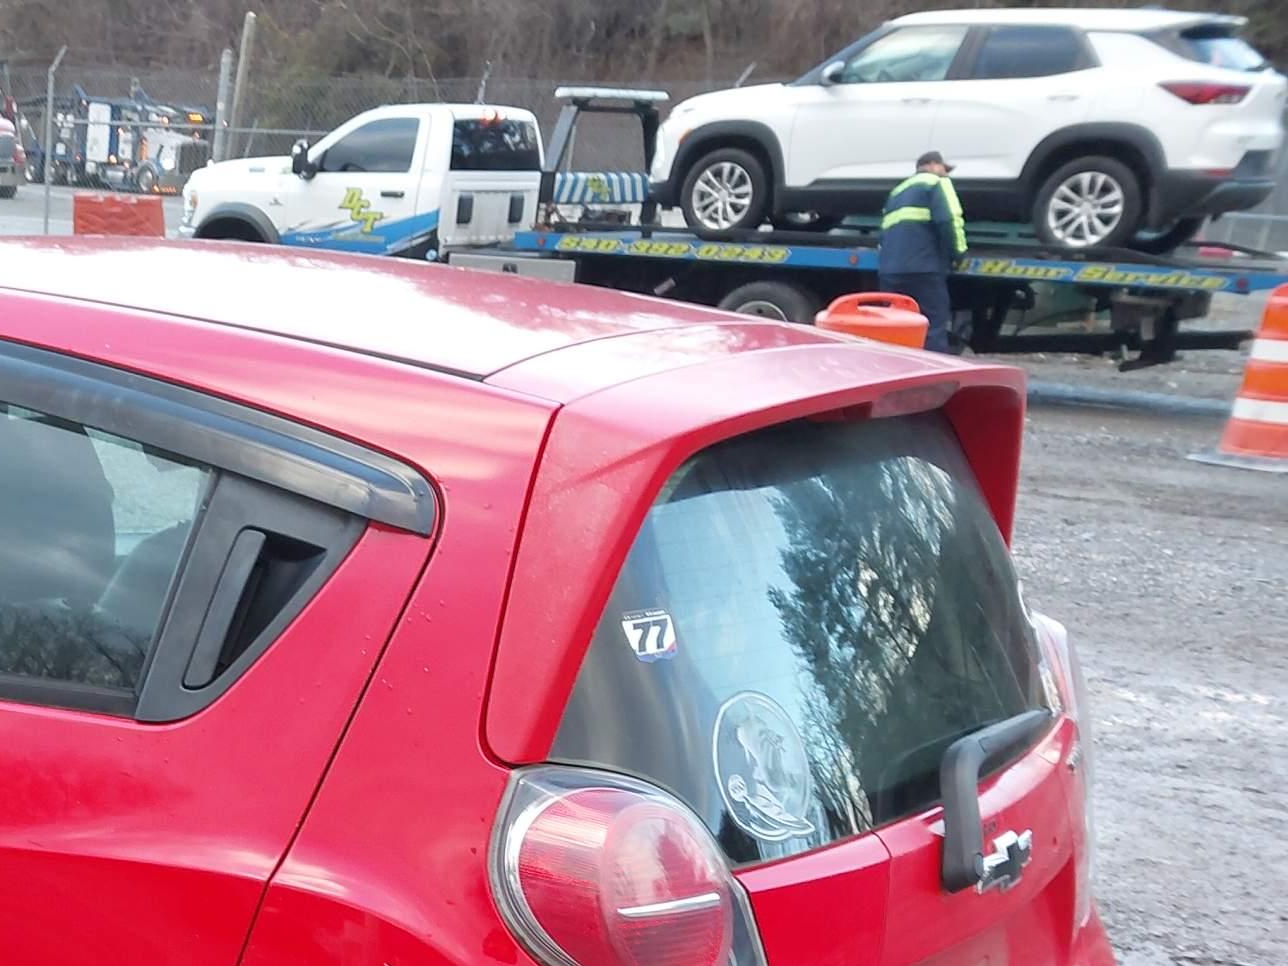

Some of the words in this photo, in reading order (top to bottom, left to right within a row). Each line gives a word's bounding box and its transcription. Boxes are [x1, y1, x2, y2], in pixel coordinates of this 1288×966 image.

[979, 259, 1069, 279] Hour
[1076, 264, 1228, 289] Service
[633, 619, 668, 653] 77
